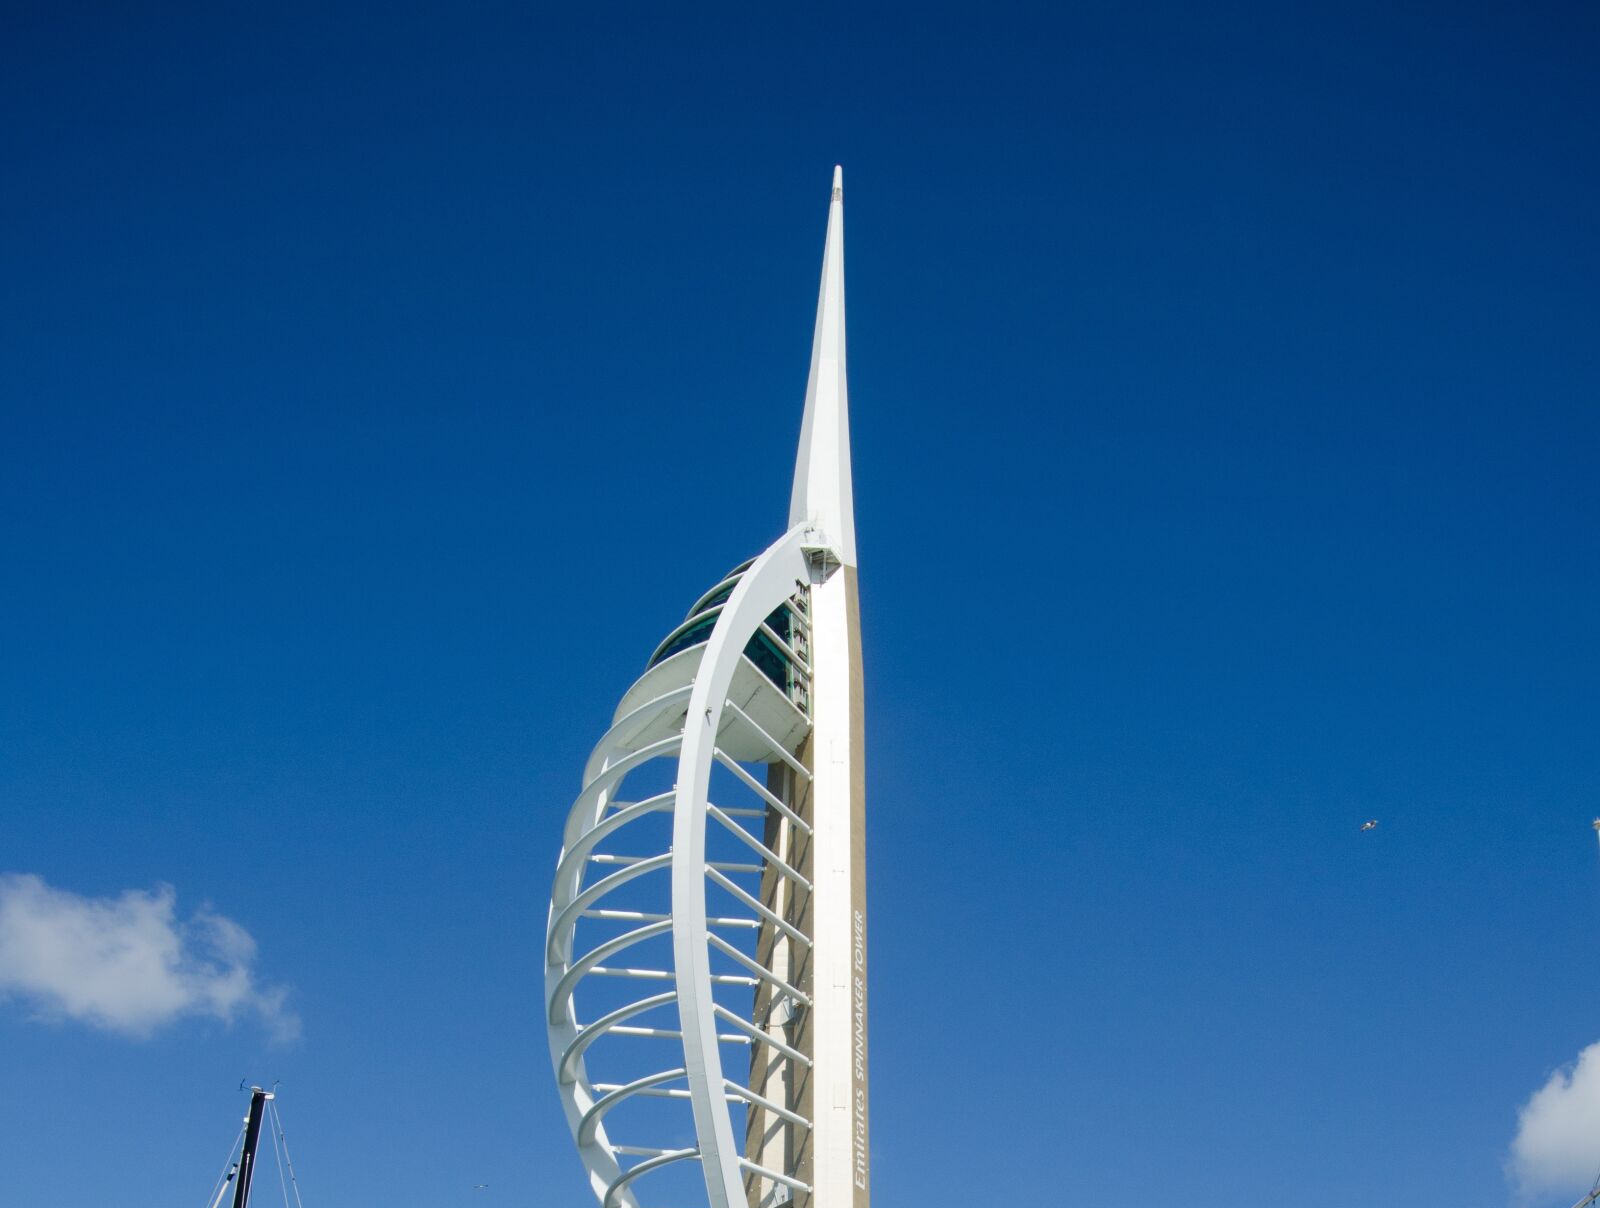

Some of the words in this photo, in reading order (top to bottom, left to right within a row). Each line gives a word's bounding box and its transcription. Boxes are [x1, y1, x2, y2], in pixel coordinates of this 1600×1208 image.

[853, 909, 863, 973] TOWER
[854, 979, 864, 1081] SPINNAKER
[854, 1087, 866, 1191] Emirates
